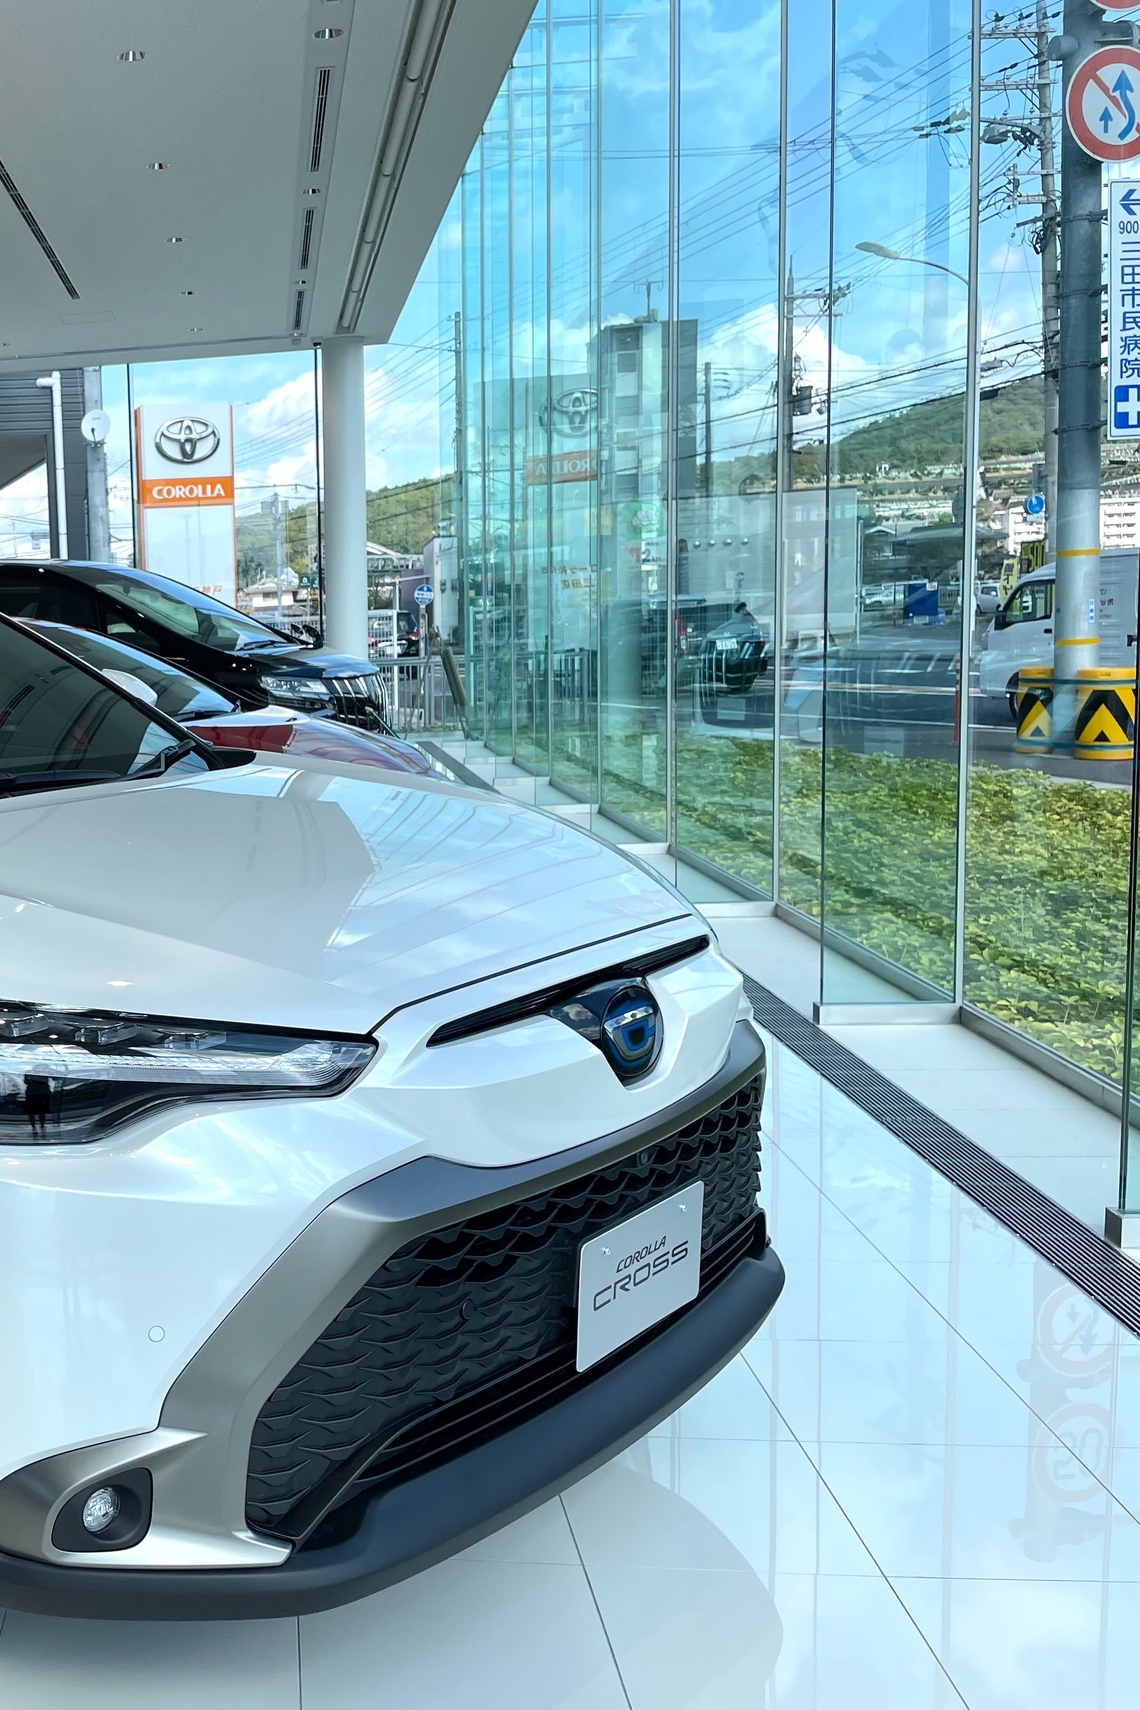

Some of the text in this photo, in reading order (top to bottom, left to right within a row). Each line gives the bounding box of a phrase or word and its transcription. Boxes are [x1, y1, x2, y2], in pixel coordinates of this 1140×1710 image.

[1119, 220, 1139, 234] 900
[1120, 241, 1140, 379] 三田市民病院
[152, 484, 225, 499] COROLLA
[615, 1235, 667, 1274] COROLLA
[593, 1240, 689, 1312] CROSS
